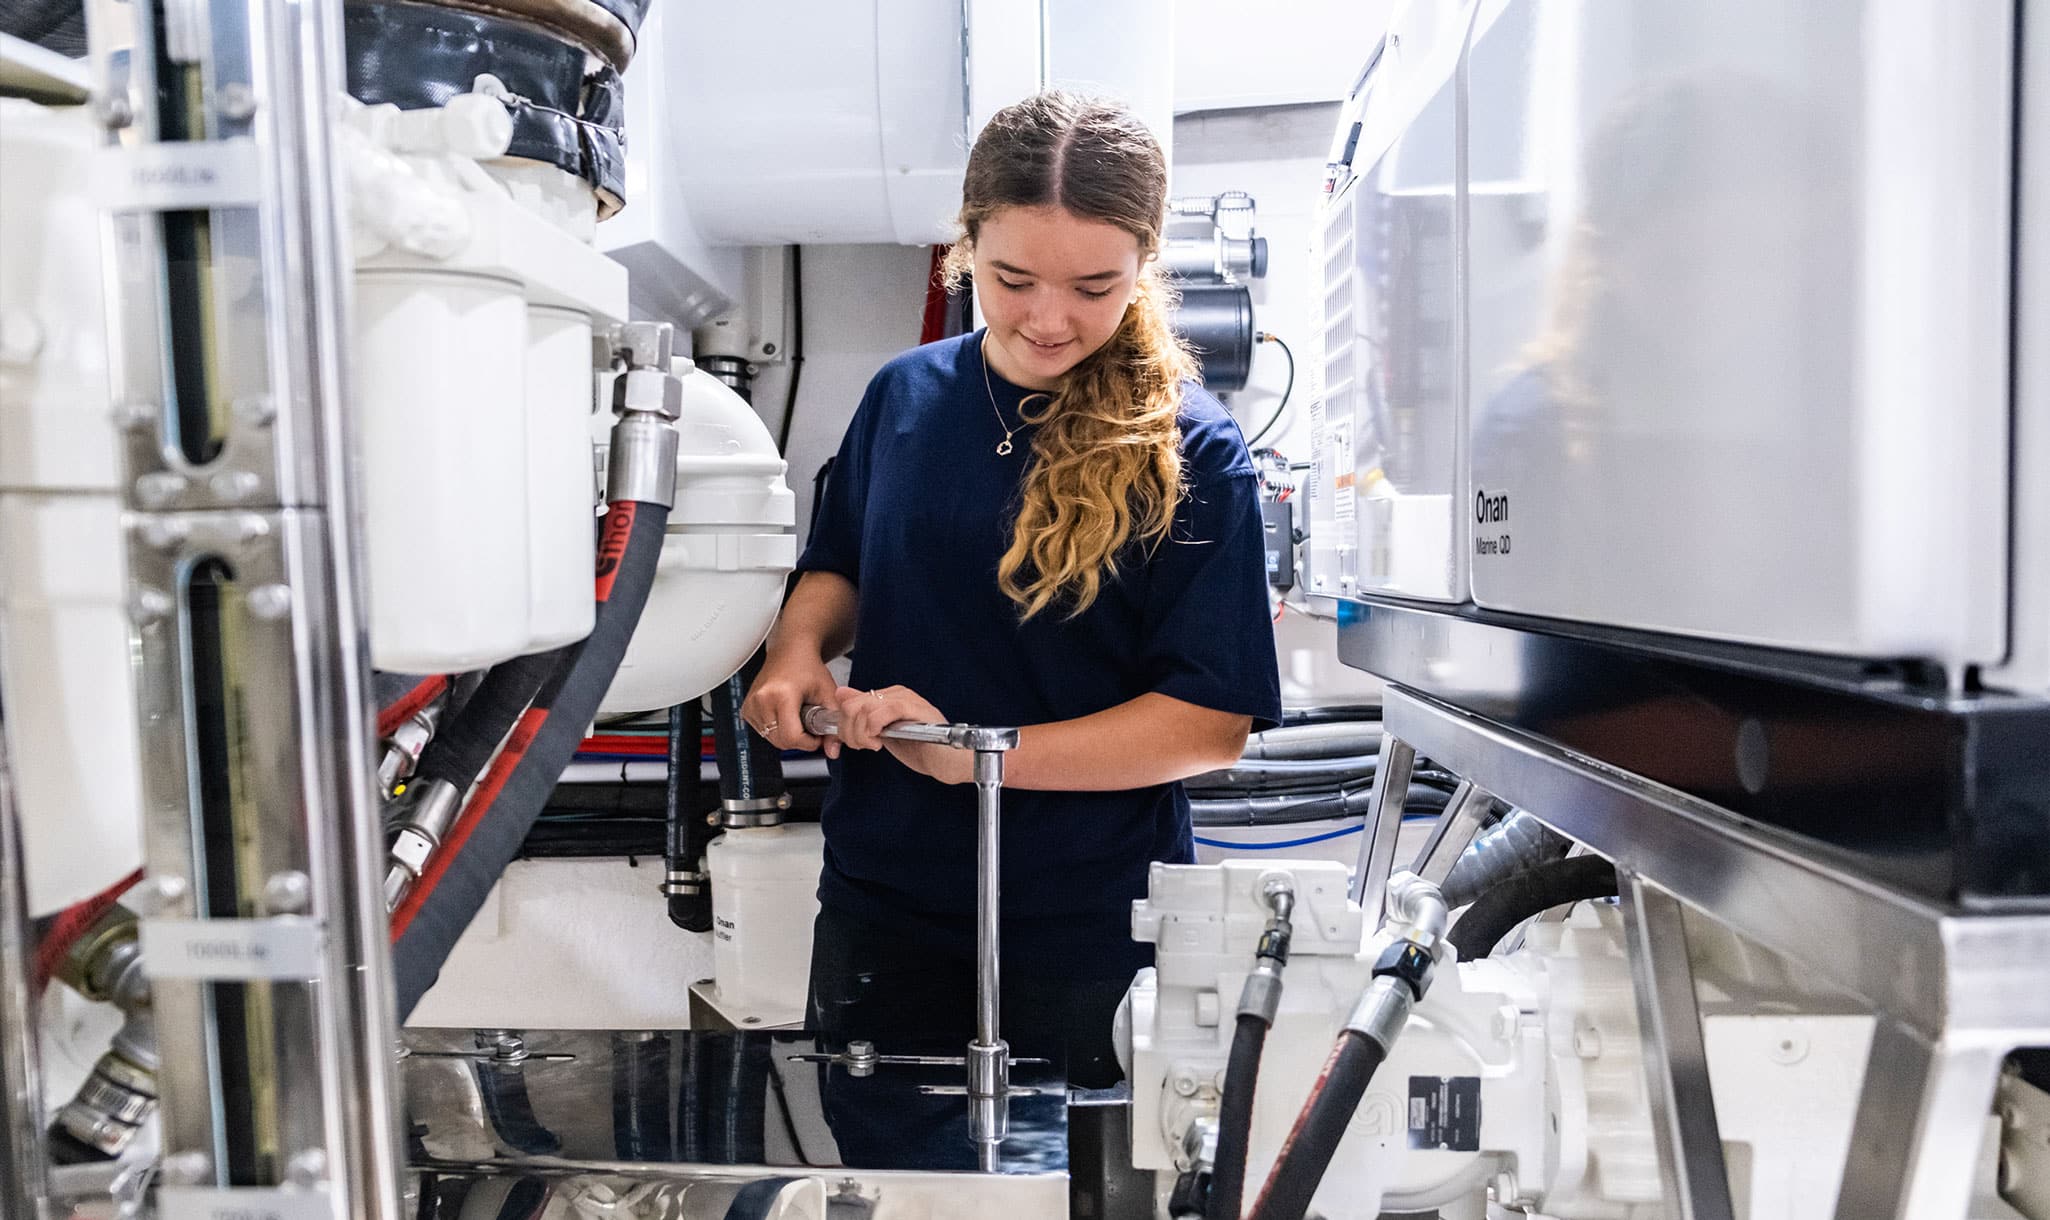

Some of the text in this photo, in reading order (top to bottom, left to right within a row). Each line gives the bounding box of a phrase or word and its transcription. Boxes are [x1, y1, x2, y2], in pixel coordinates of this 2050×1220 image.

[1476, 490, 1508, 524] Onan
[1476, 535, 1511, 554] Marine QD
